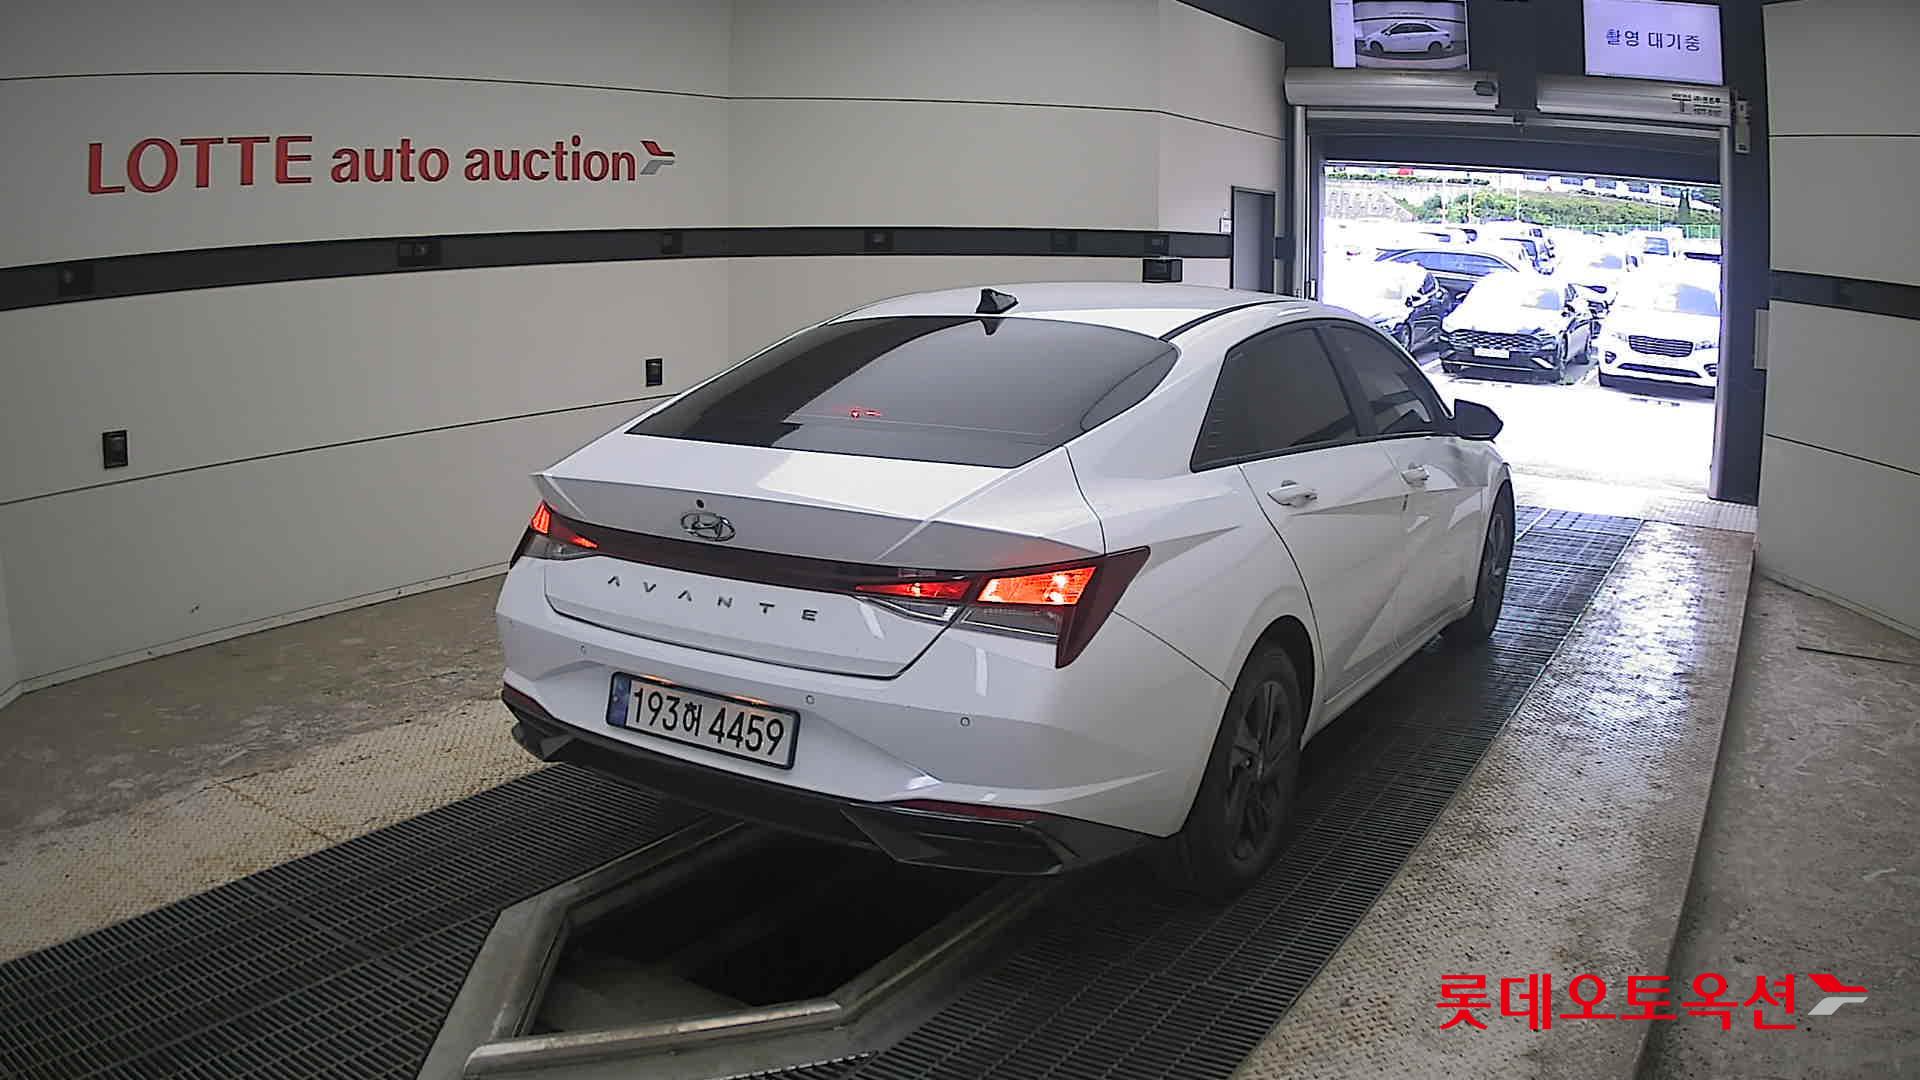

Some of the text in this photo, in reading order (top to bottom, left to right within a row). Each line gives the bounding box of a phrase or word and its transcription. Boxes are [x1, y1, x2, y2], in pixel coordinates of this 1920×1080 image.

[1648, 32, 1701, 52] 대기중
[88, 135, 636, 194] LOTTE auto auction
[607, 575, 818, 622] AVANTE
[634, 687, 784, 755] 193허 4459
